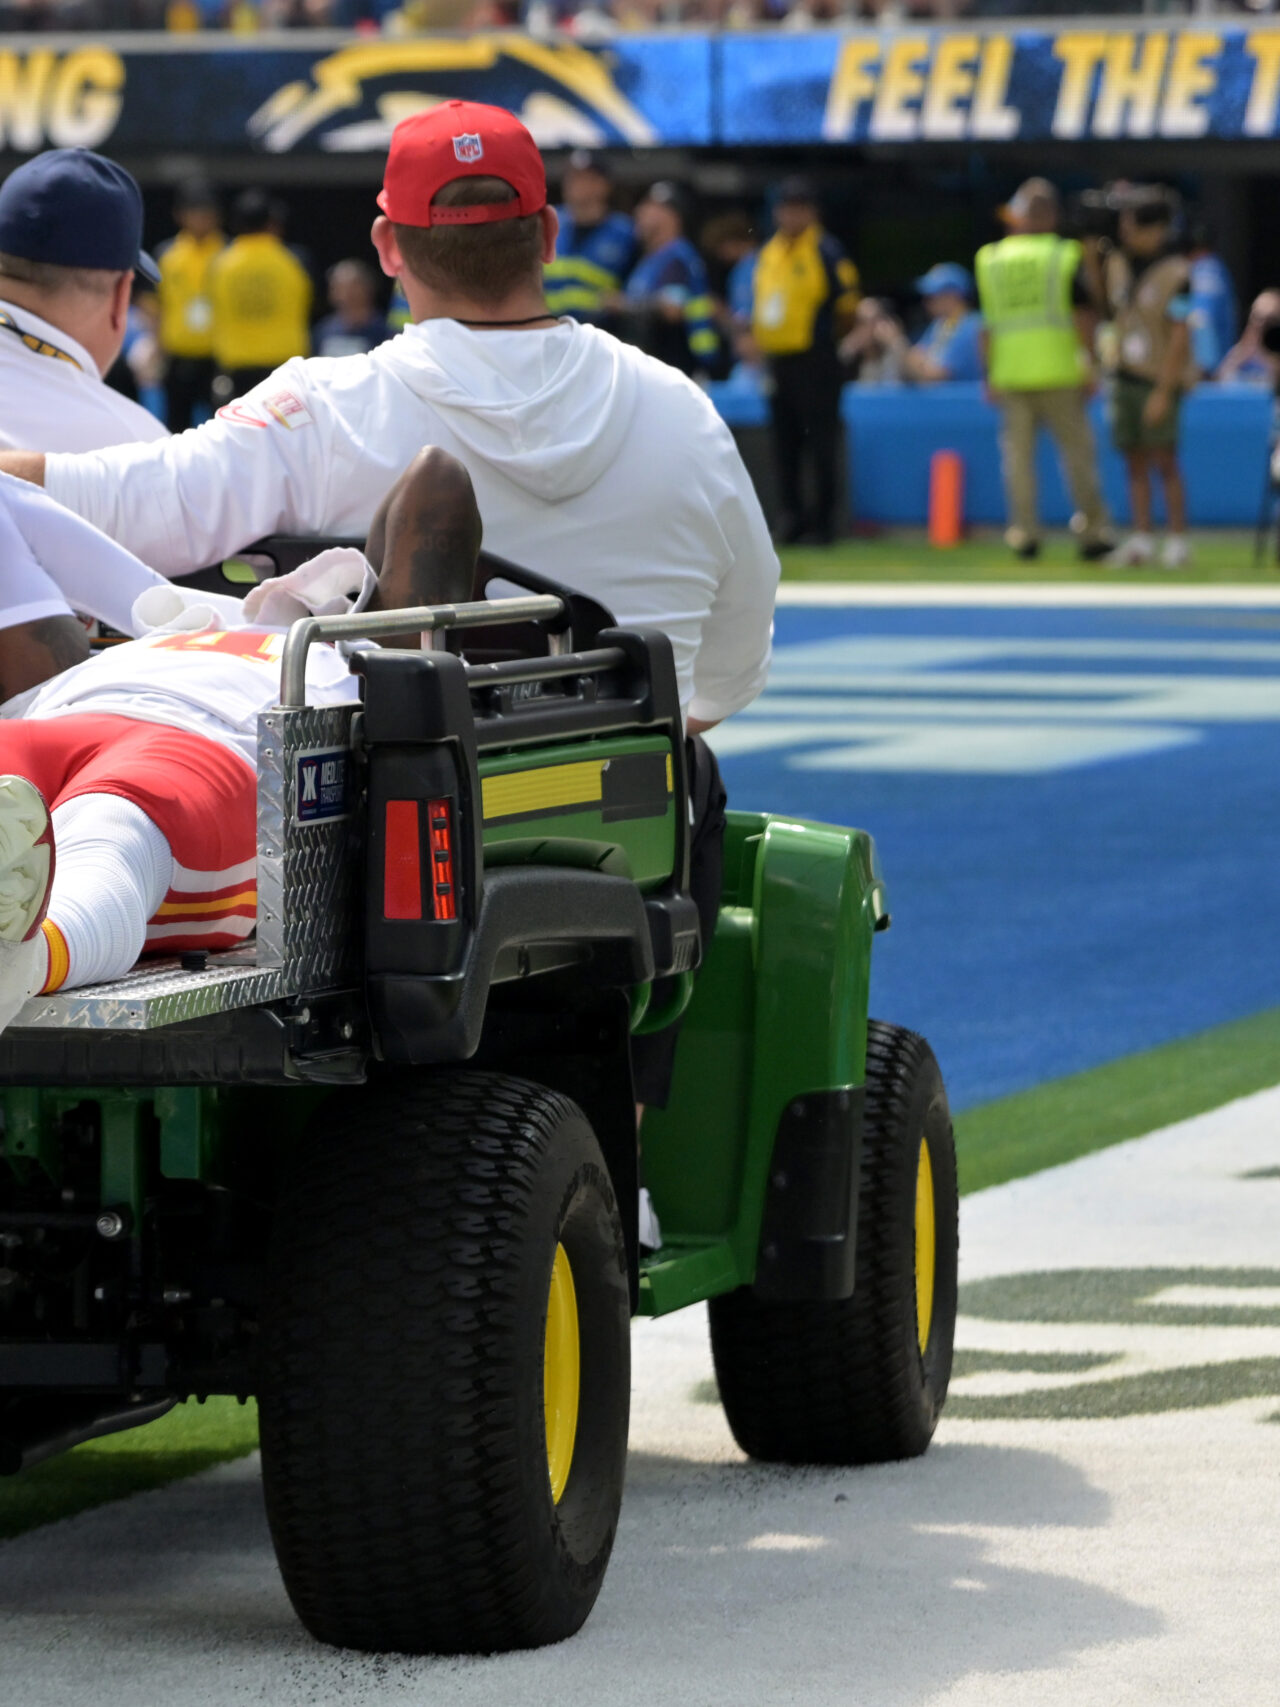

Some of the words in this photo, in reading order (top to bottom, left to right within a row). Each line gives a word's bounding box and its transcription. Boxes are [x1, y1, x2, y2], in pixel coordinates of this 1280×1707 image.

[822, 31, 1021, 142] FEEL
[1051, 31, 1225, 139] THE
[458, 144, 481, 158] NFL
